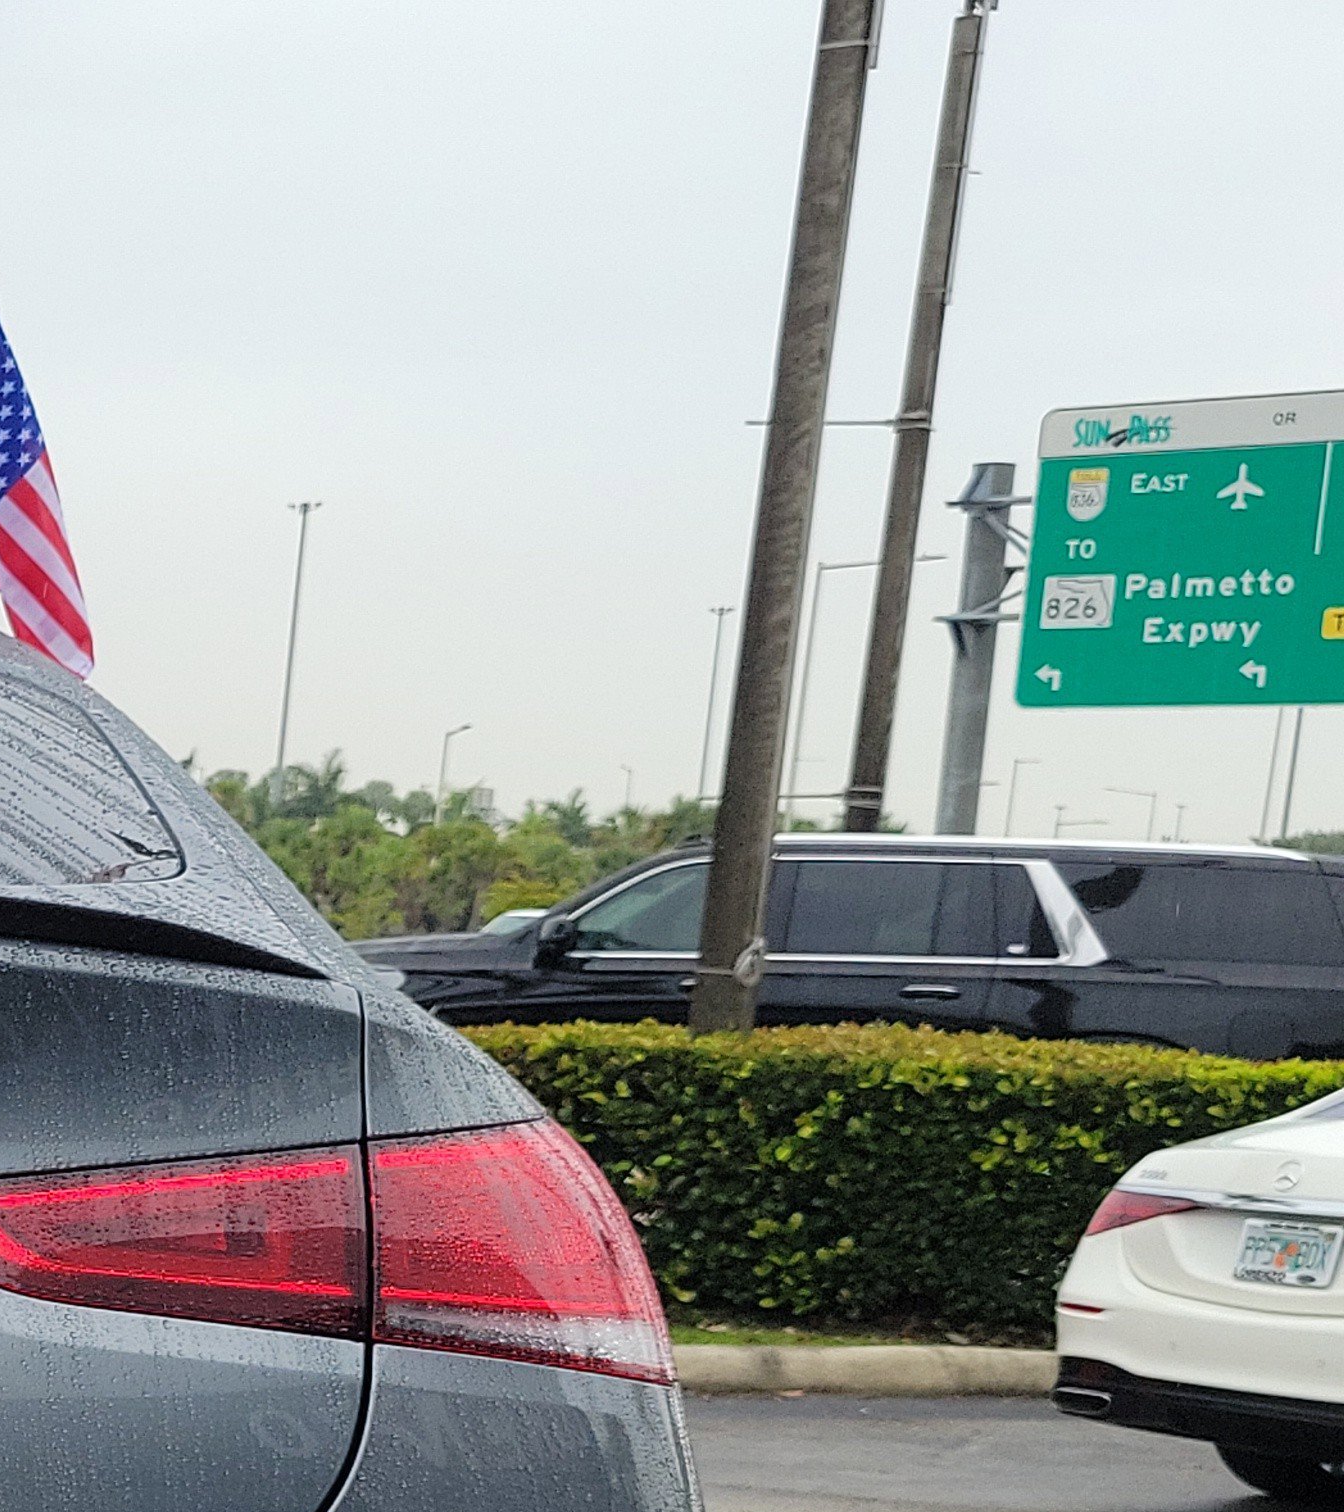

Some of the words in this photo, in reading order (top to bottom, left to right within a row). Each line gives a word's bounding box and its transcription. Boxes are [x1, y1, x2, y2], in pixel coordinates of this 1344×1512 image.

[1272, 411, 1297, 427] OR
[1130, 473, 1189, 494] EAST
[1065, 538, 1097, 559] TO
[1124, 568, 1295, 600] Palmetto
[1046, 597, 1097, 619] 826
[1142, 616, 1262, 648] Expwy
